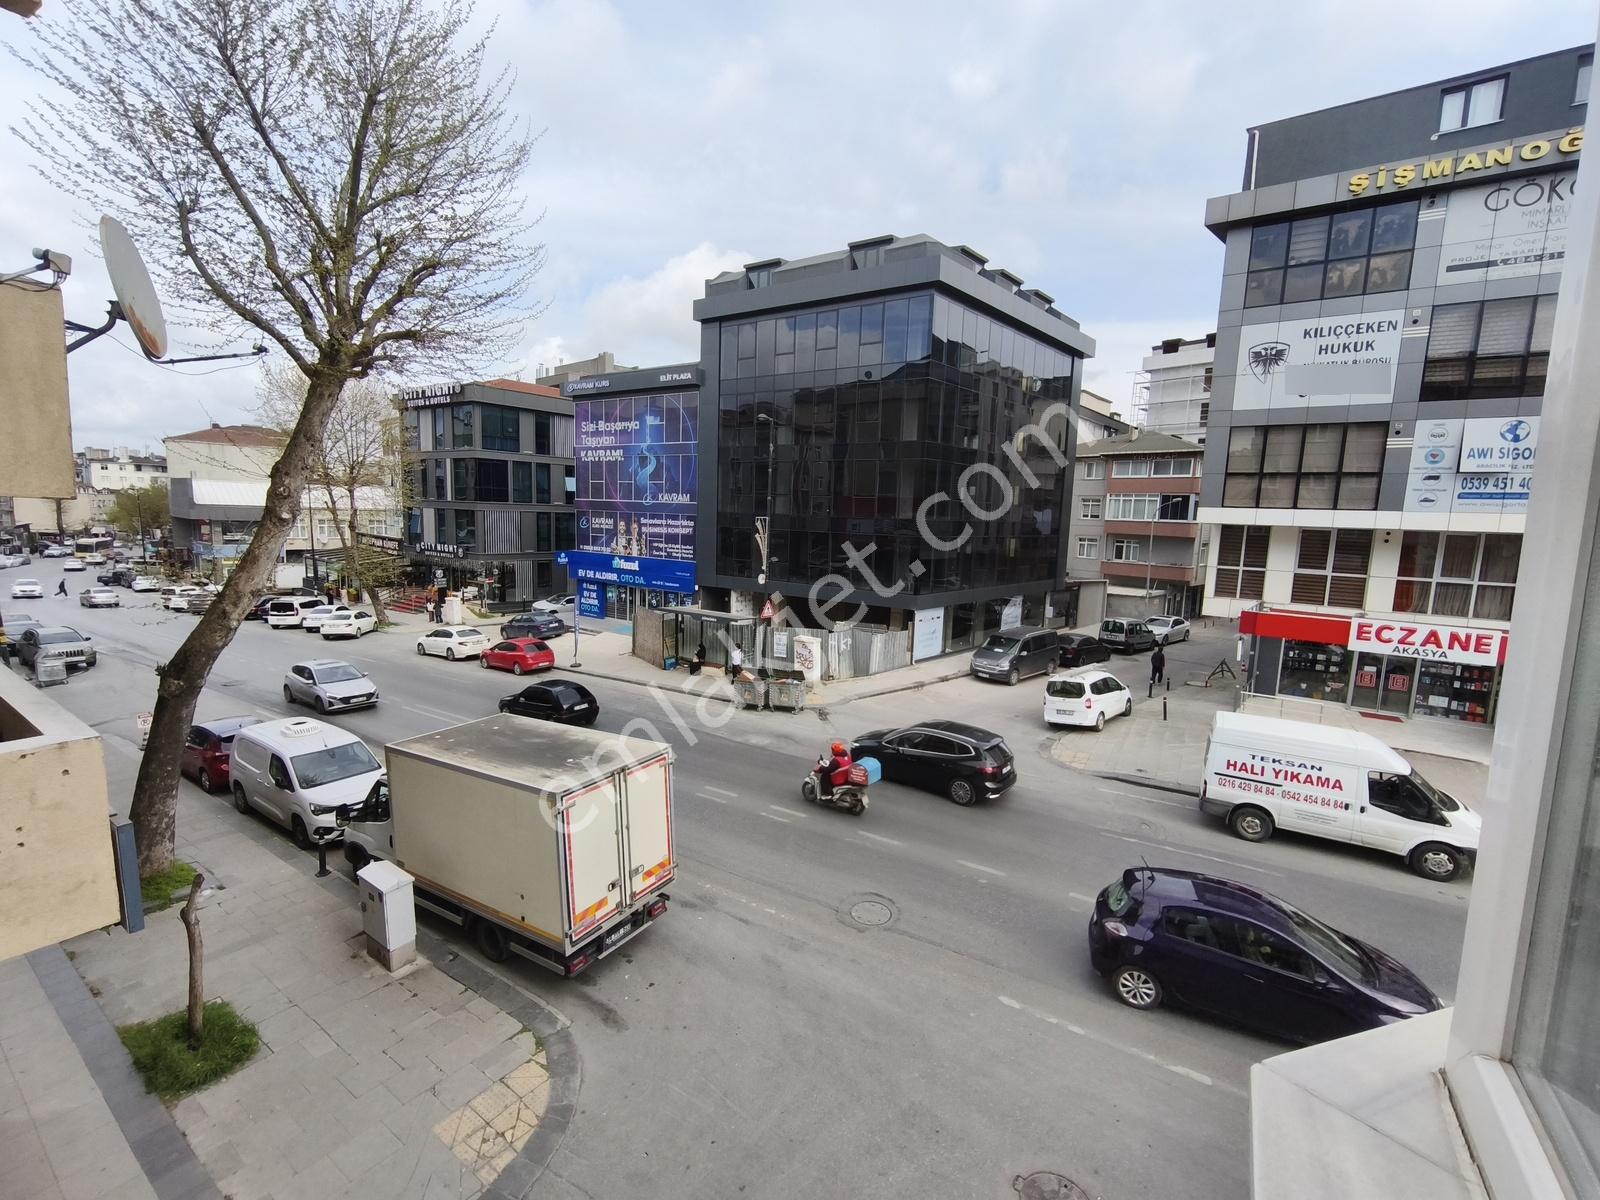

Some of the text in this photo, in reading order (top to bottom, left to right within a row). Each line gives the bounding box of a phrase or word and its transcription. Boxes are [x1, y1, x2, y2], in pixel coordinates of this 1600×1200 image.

[1303, 319, 1398, 340] KILIÇÇEKEN
[1318, 339, 1375, 356] HUKUK
[672, 372, 692, 381] PLAZA
[1461, 477, 1490, 490] 0539
[1493, 477, 1514, 490] 451
[658, 493, 690, 502] KAVRAM
[420, 541, 457, 553] CITY NIGHT
[578, 569, 587, 578] EV
[586, 569, 595, 578] DE
[620, 574, 634, 583] OTO
[1356, 622, 1494, 654] ECZANE
[1391, 645, 1448, 660] AKASYA
[1248, 753, 1323, 772] TEKSAN
[1226, 759, 1343, 792] HALI YIKAMA
[1217, 777, 1236, 789] 0216
[1238, 781, 1252, 792] 429
[1253, 784, 1264, 794] 84
[1265, 786, 1275, 796] 84
[1281, 790, 1301, 802] 0542
[1303, 794, 1319, 805] 454
[1320, 797, 1331, 807] 84
[1333, 799, 1344, 810] 84
